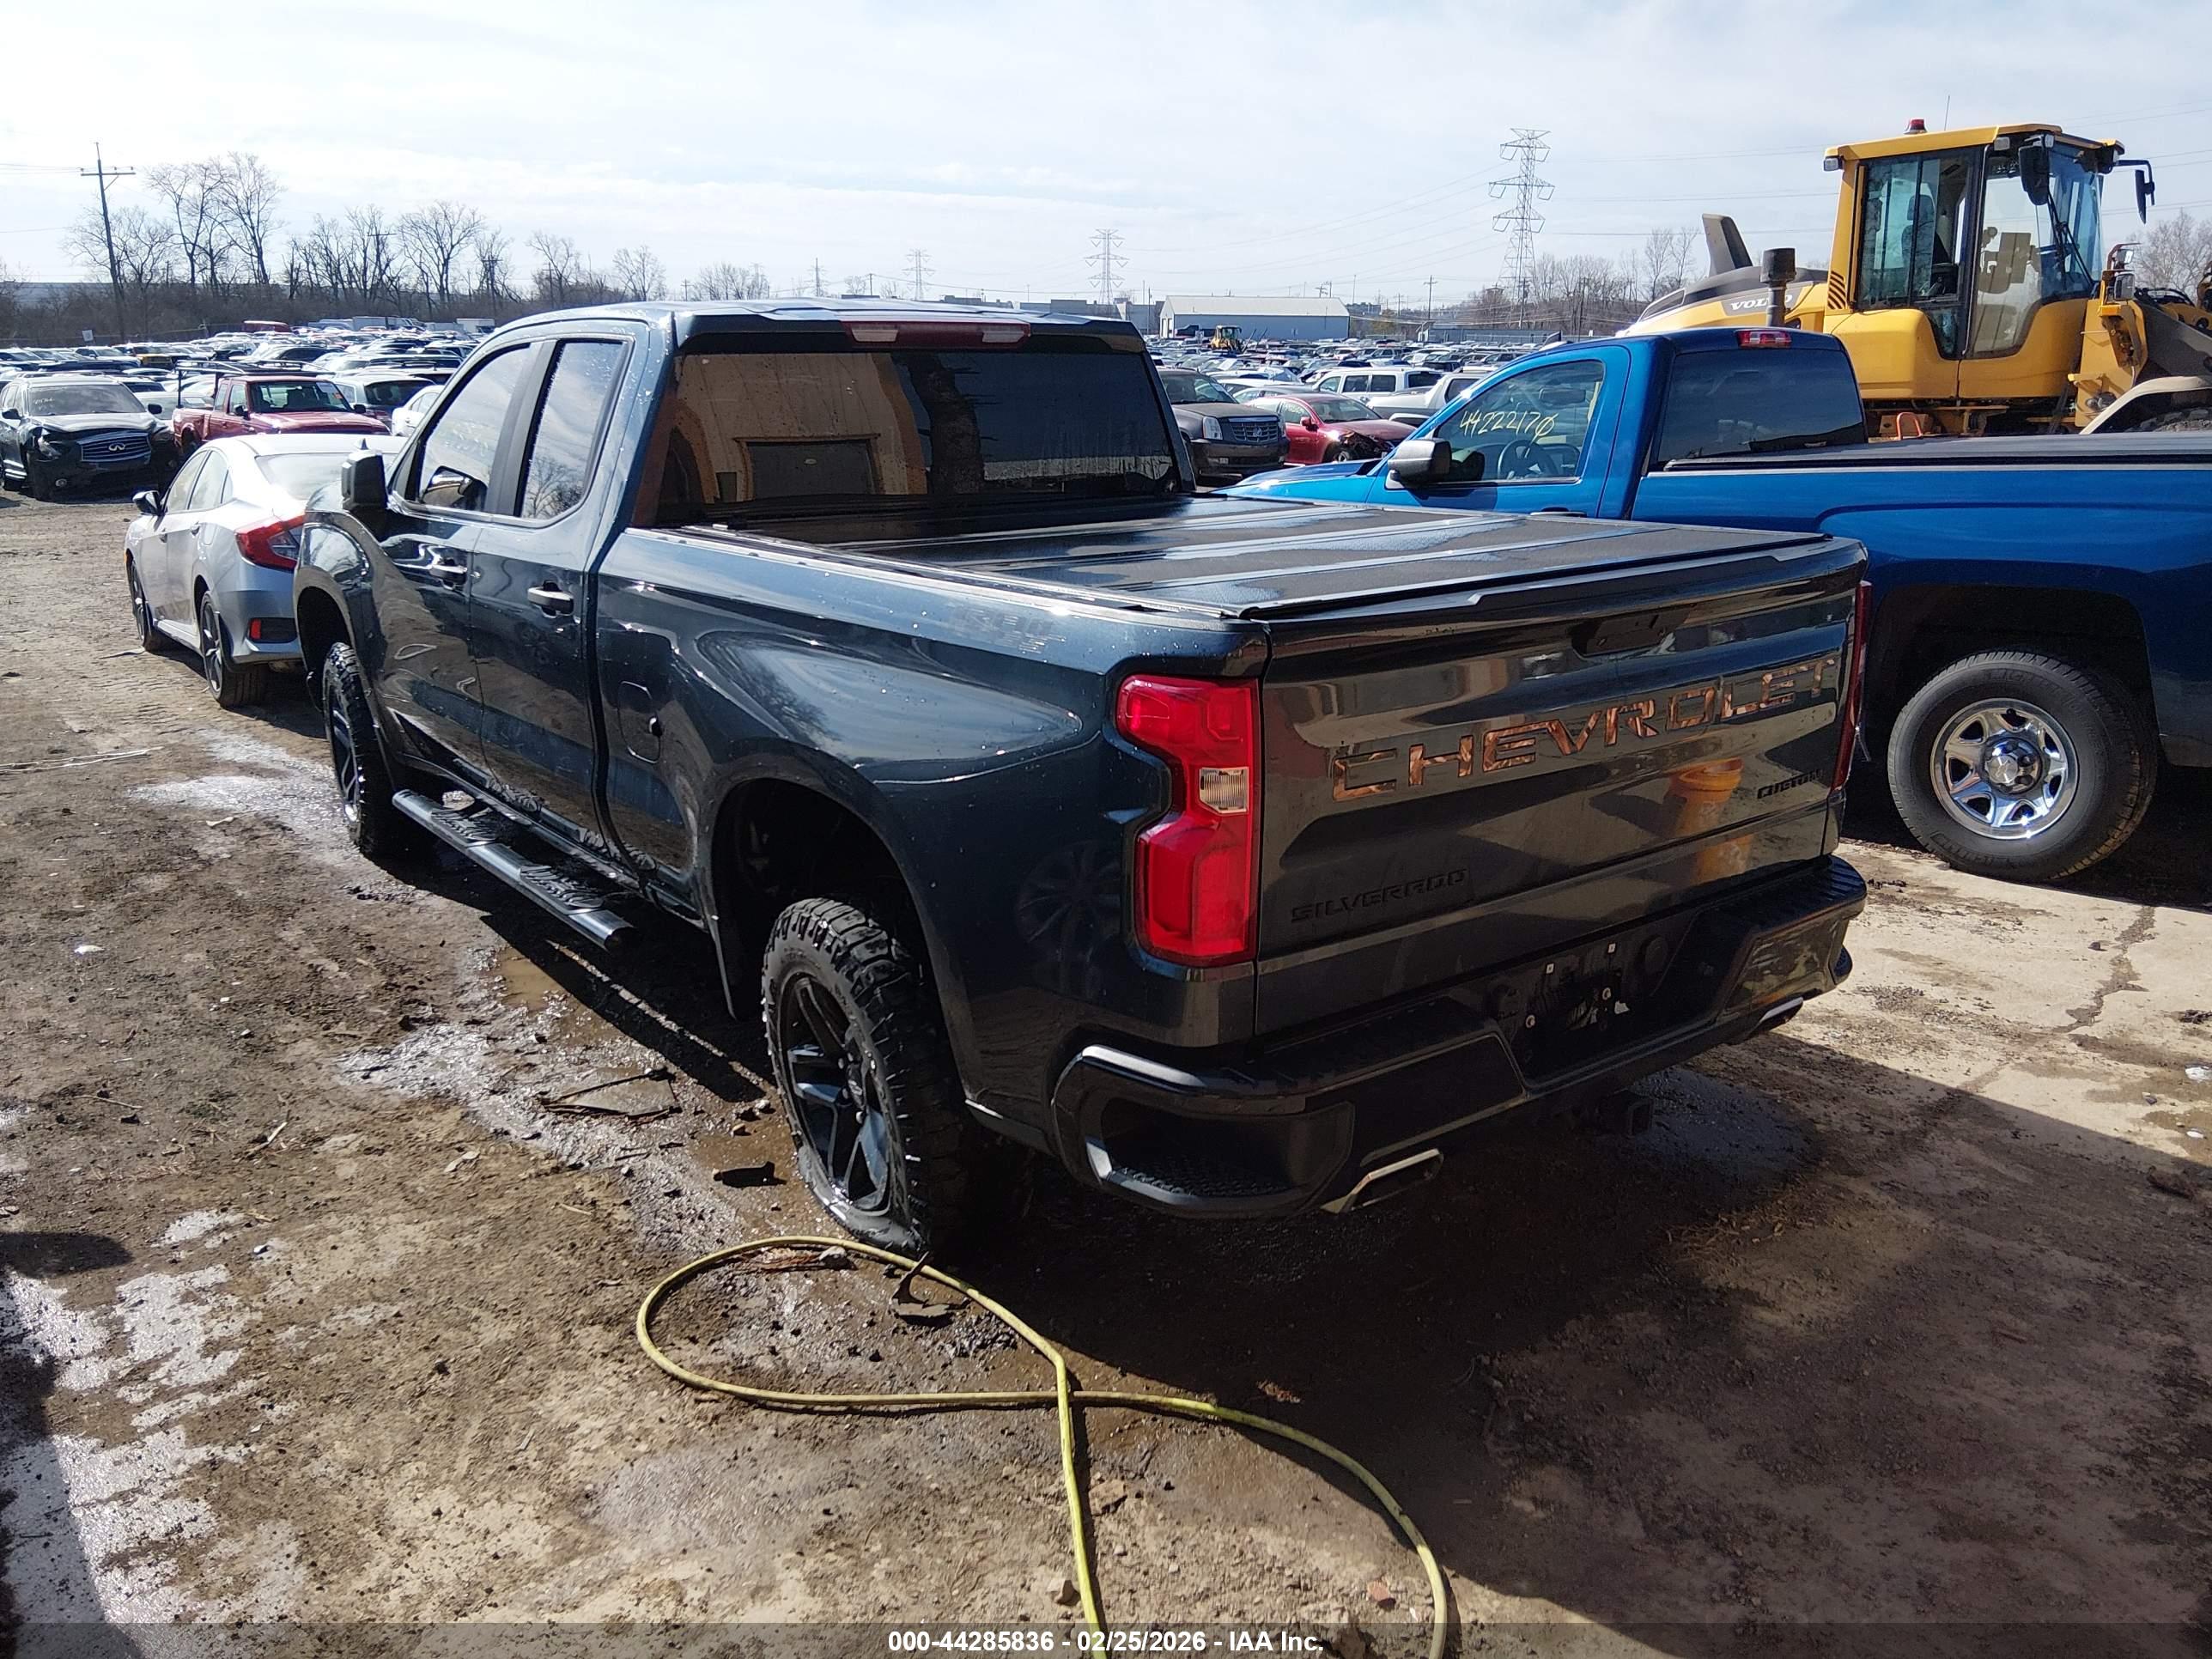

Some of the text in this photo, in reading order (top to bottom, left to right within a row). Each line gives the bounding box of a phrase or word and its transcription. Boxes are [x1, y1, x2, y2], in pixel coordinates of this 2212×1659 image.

[1730, 294, 1793, 311] VOLO
[1330, 658, 1836, 802] CHEVROLET
[1291, 868, 1469, 923] SILVERADO
